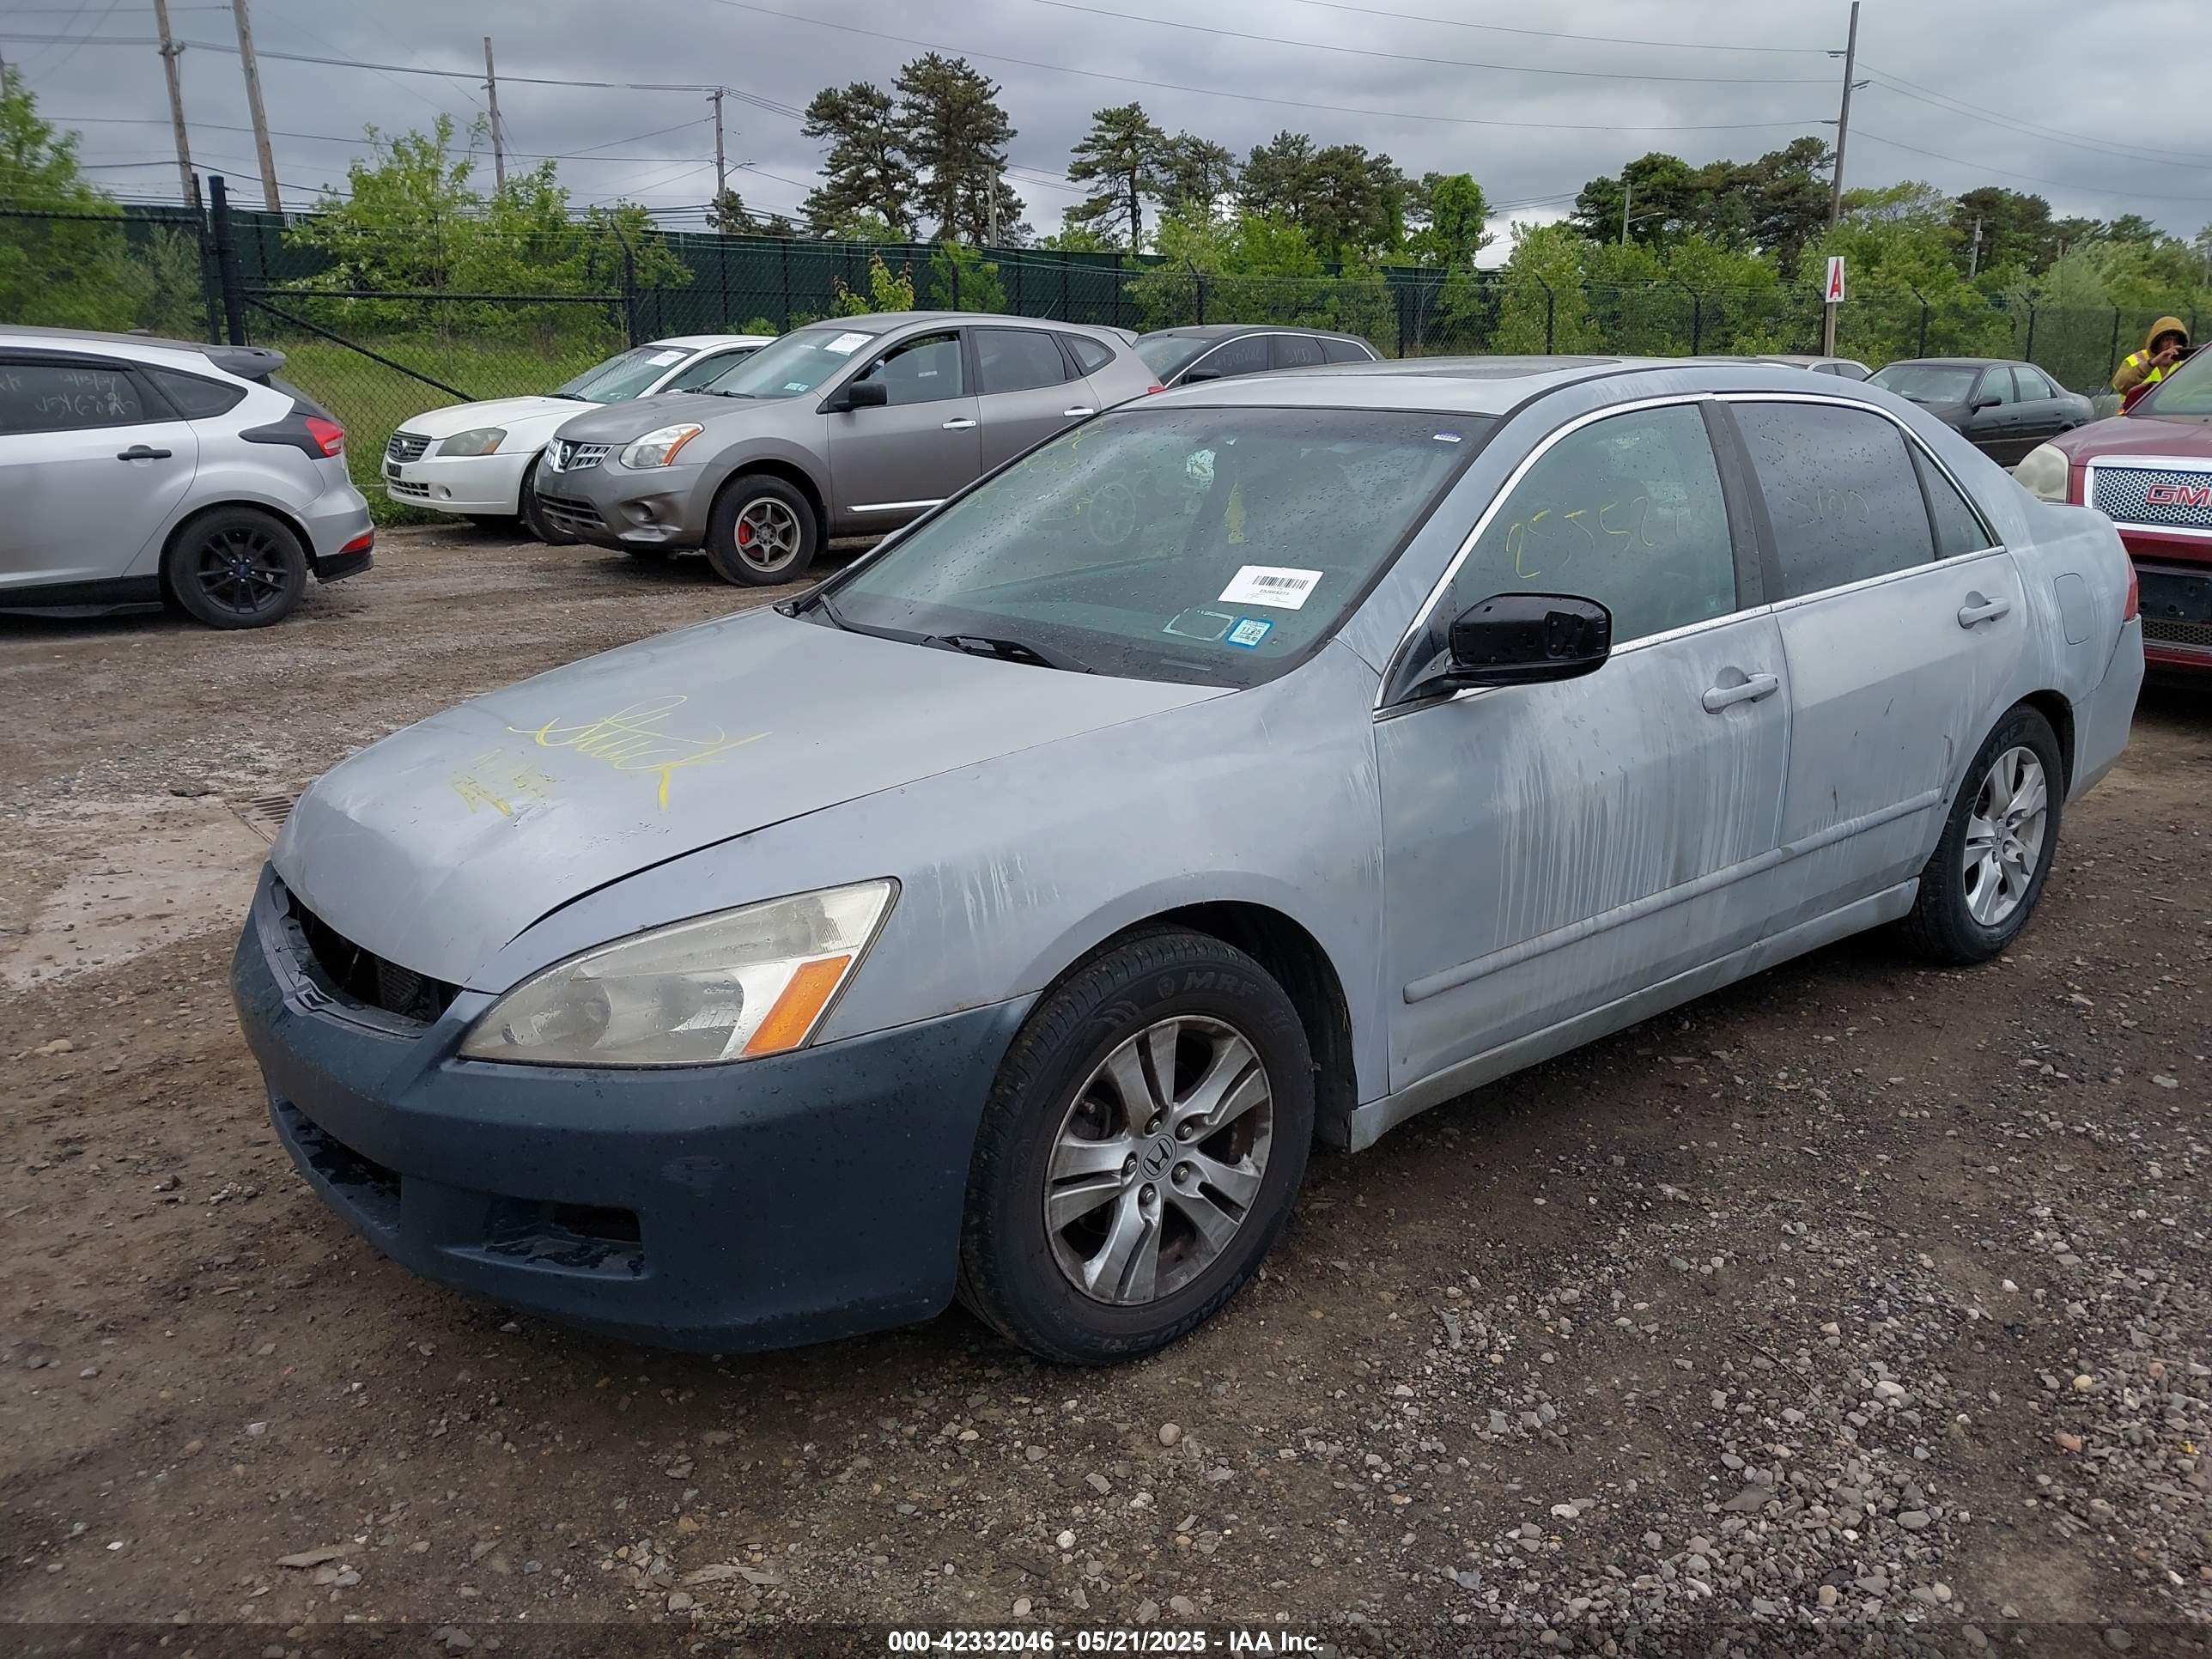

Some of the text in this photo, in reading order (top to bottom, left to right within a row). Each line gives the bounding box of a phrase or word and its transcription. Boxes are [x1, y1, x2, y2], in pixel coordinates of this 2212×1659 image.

[1829, 260, 1842, 298] A
[2146, 483, 2212, 507] GM
[1183, 971, 1260, 997] MRF
